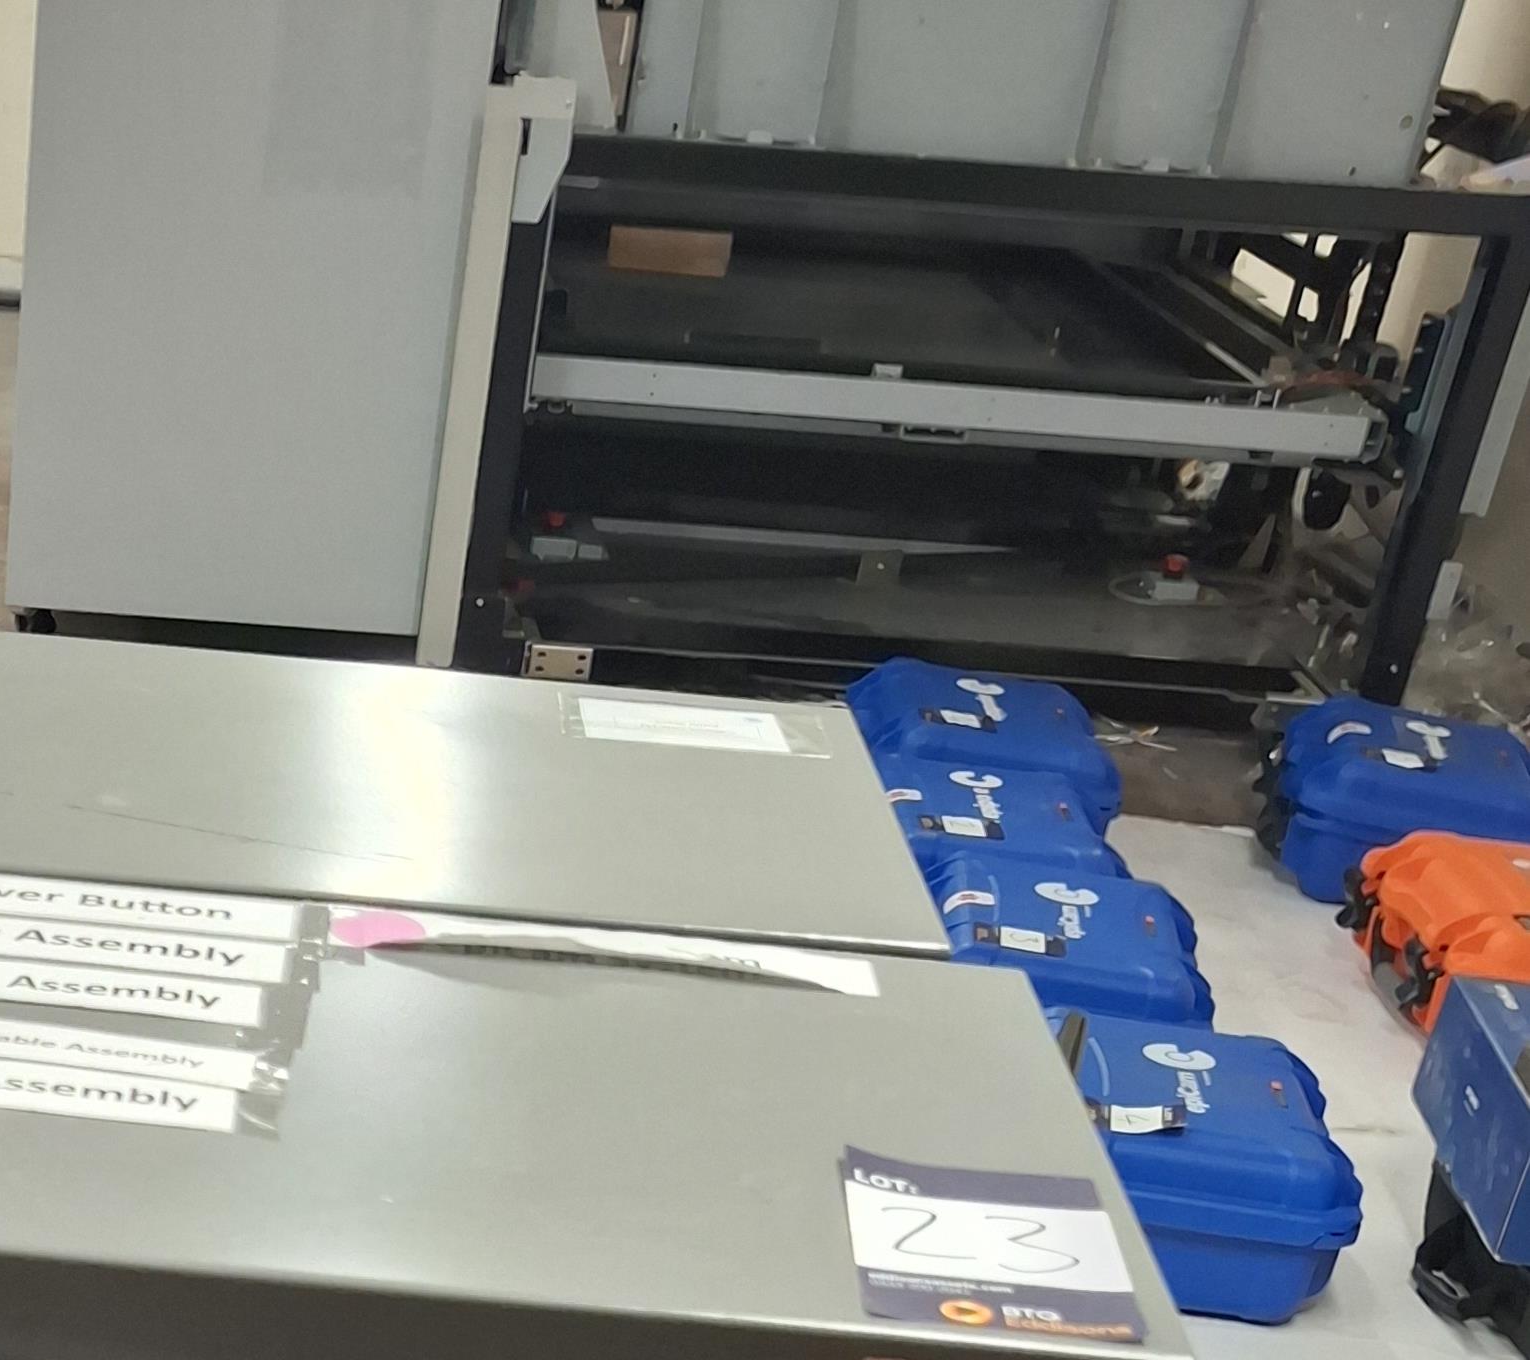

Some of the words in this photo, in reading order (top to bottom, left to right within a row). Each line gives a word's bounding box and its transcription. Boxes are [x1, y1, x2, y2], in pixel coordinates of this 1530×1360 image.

[79, 893, 235, 921] Button
[15, 929, 246, 968] Assembly
[6, 974, 221, 1011] Assembly
[63, 1041, 204, 1070] Assembly
[852, 1166, 919, 1195] LOT:
[881, 1206, 1080, 1274] 23
